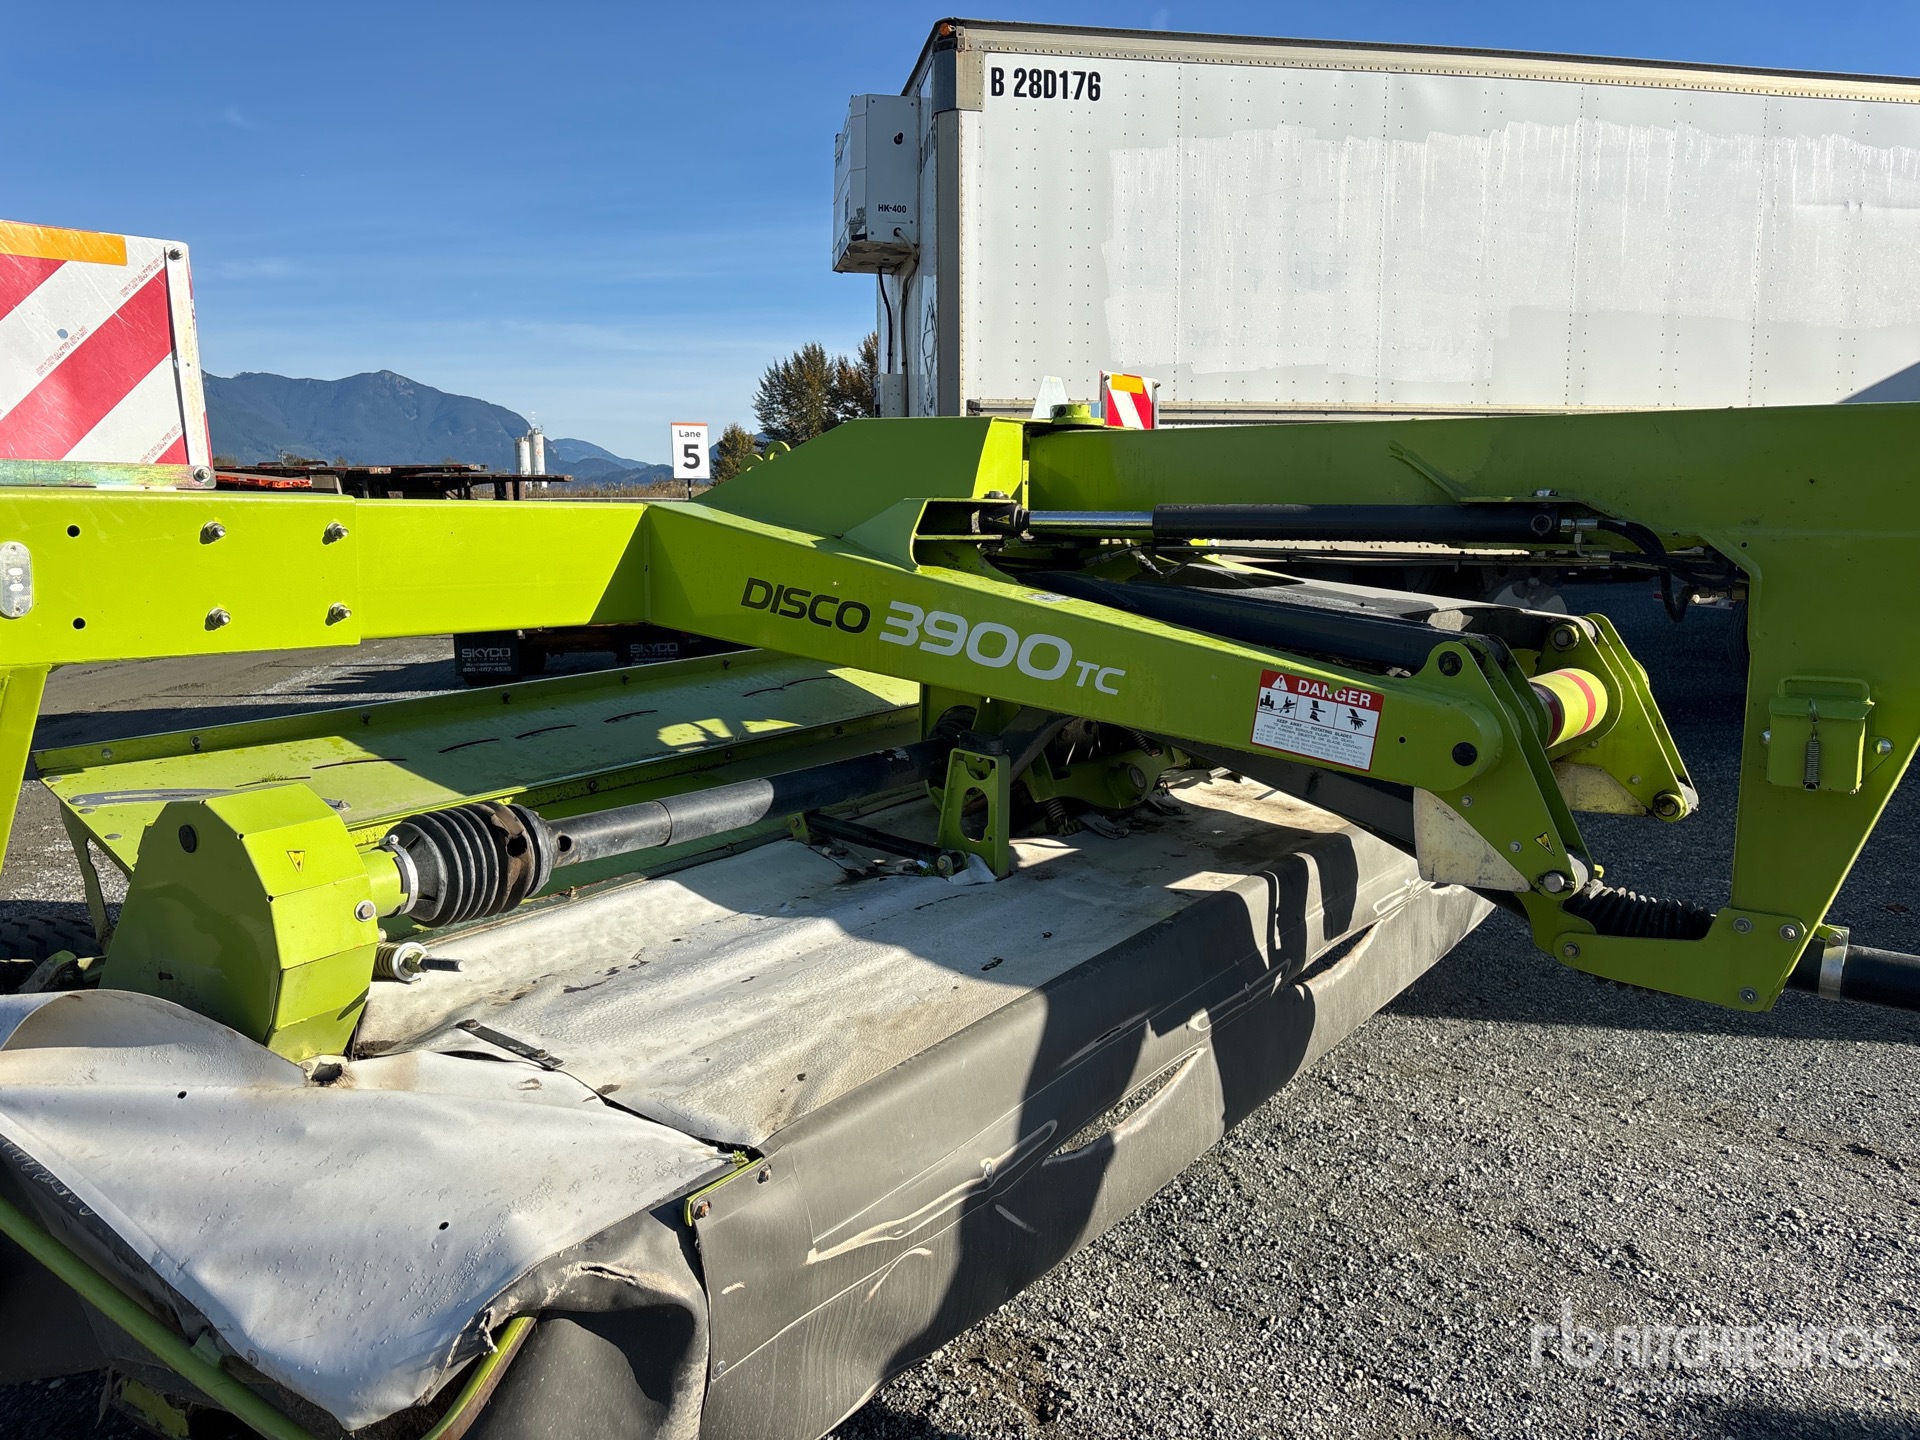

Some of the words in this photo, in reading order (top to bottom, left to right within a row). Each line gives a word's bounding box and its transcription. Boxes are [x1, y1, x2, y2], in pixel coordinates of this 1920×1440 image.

[991, 67, 1004, 97] B
[1014, 68, 1101, 101] 28D176
[878, 203, 907, 214] HK-400
[678, 430, 702, 438] Lane
[683, 444, 700, 470] 5
[741, 577, 871, 634] DISCO
[462, 648, 510, 658] SKYCO
[1298, 680, 1372, 708] DANGER
